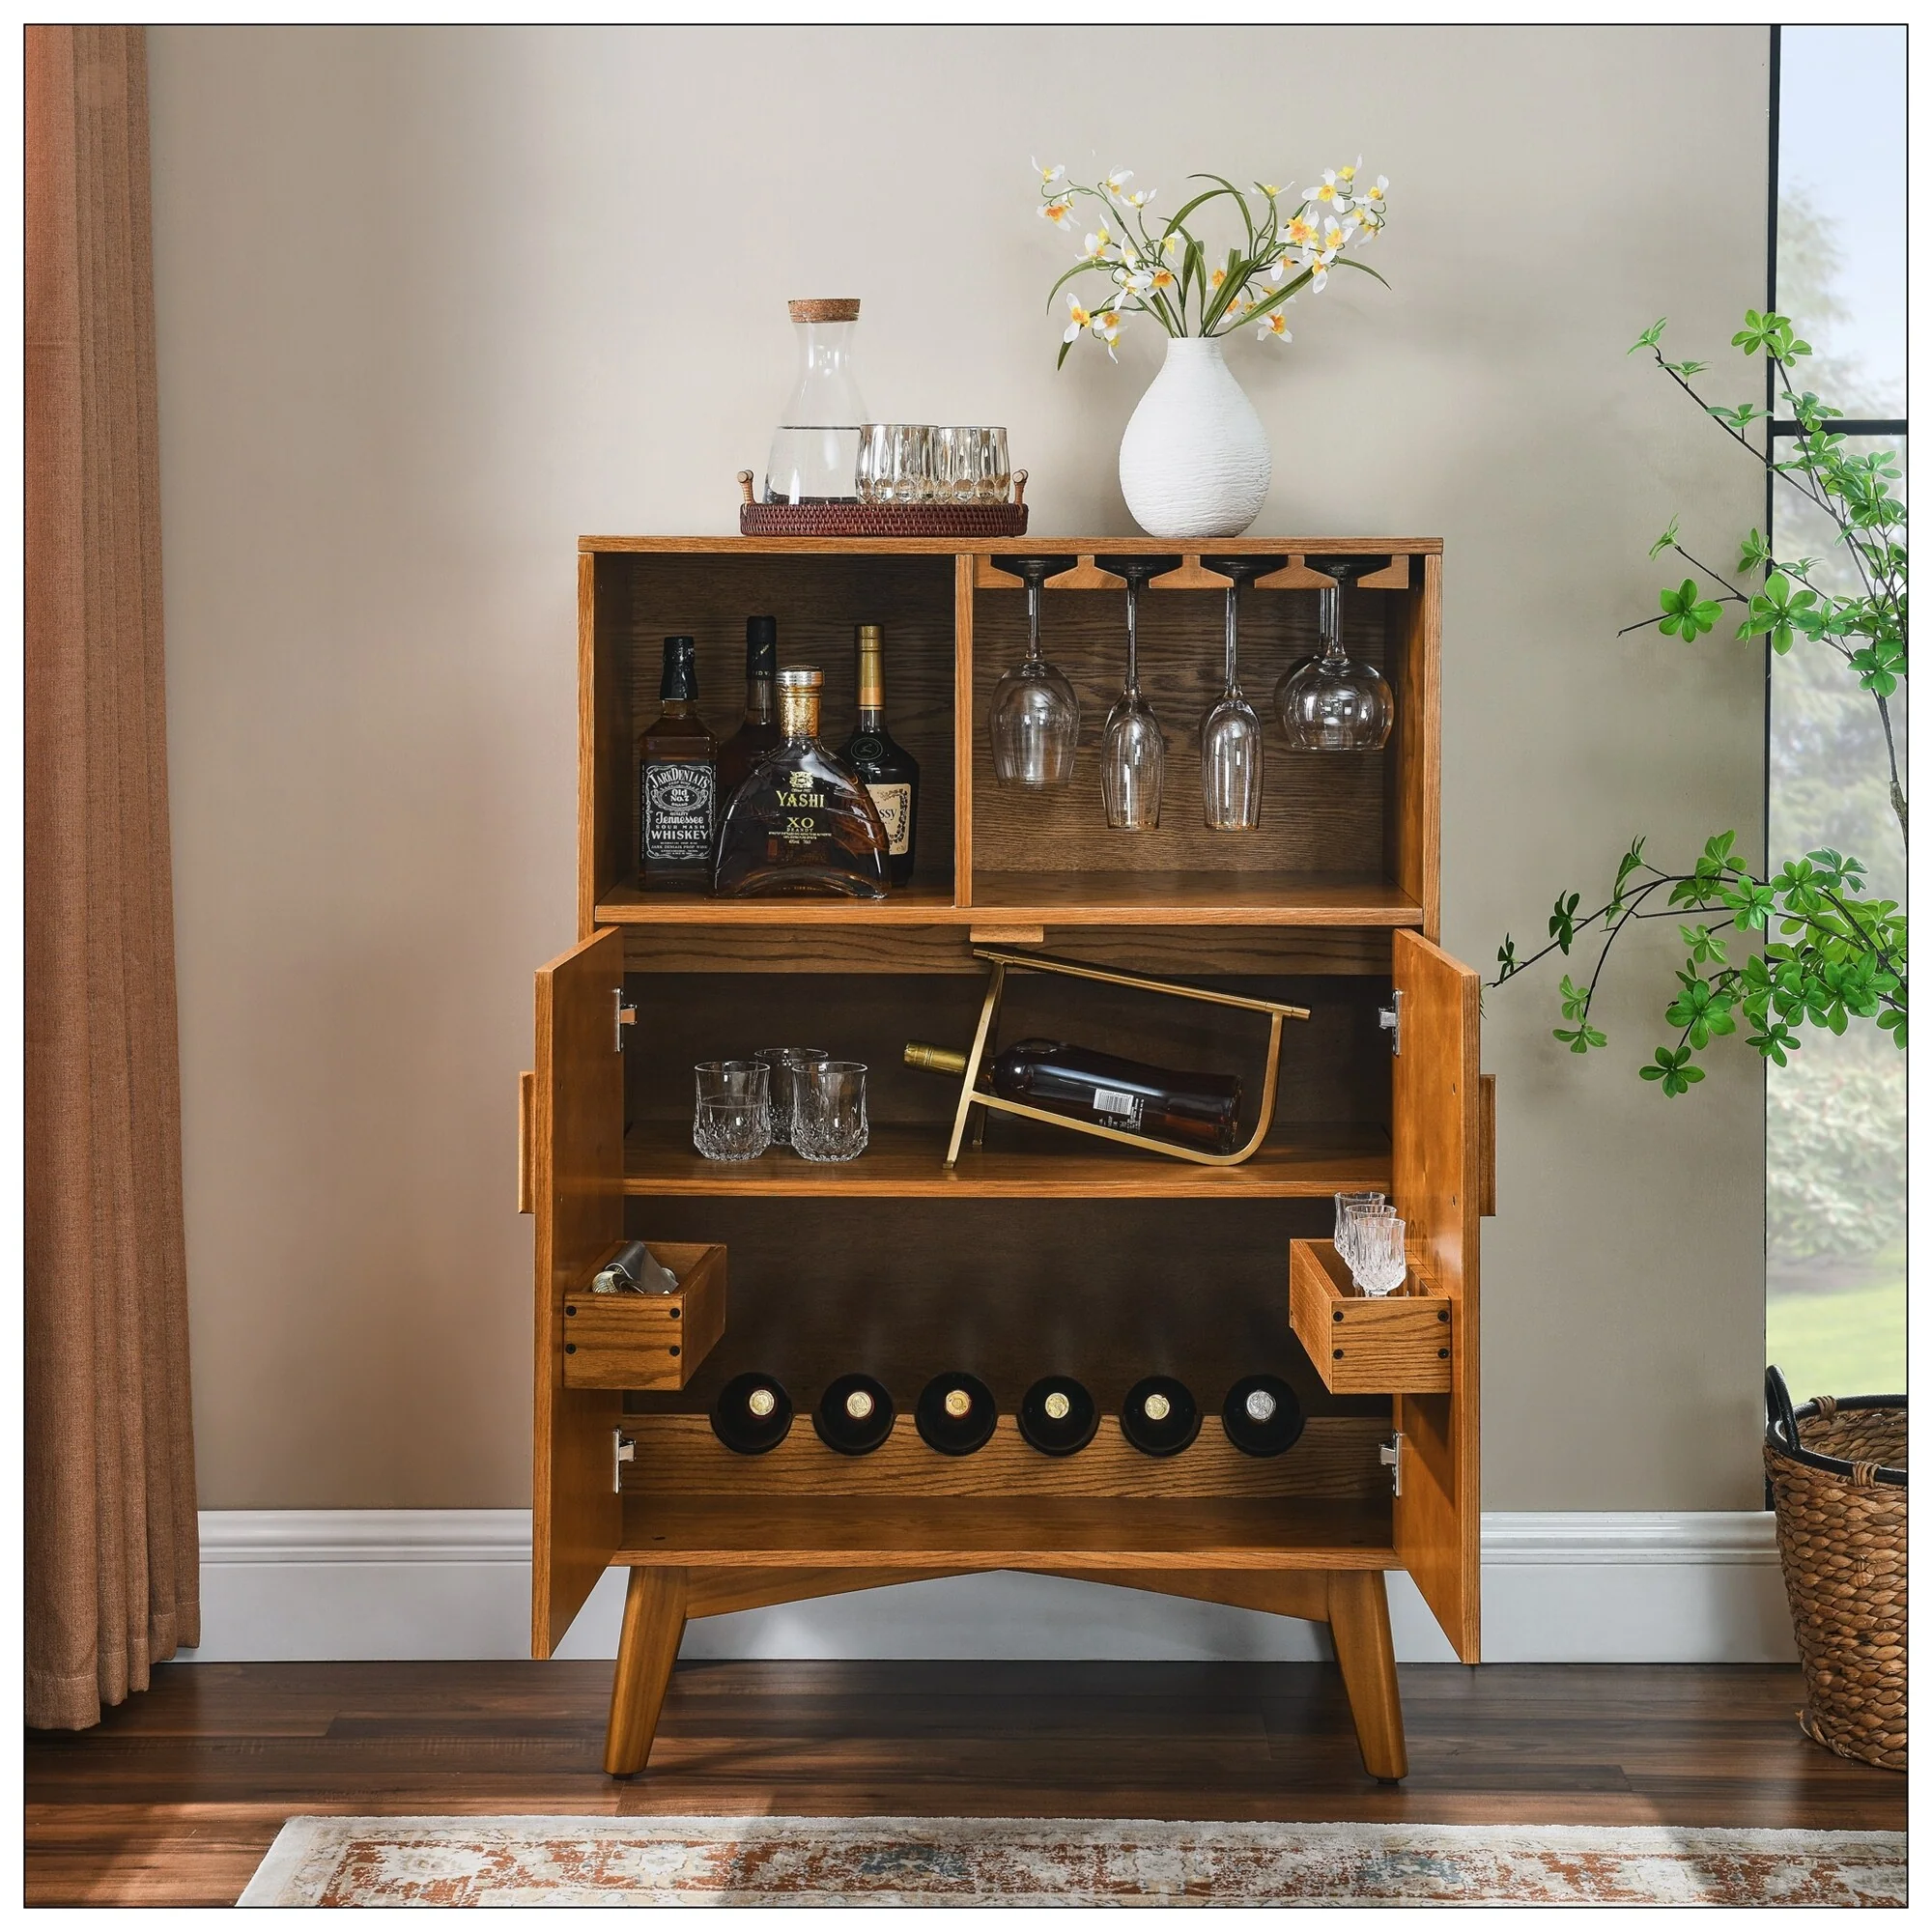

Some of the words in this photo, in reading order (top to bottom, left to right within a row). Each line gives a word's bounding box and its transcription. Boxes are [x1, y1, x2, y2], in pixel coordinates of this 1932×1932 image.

[776, 790, 825, 808] YASHI
[655, 811, 704, 824] Tennessee
[786, 816, 814, 829] XO
[651, 830, 709, 840] WHISKEY
